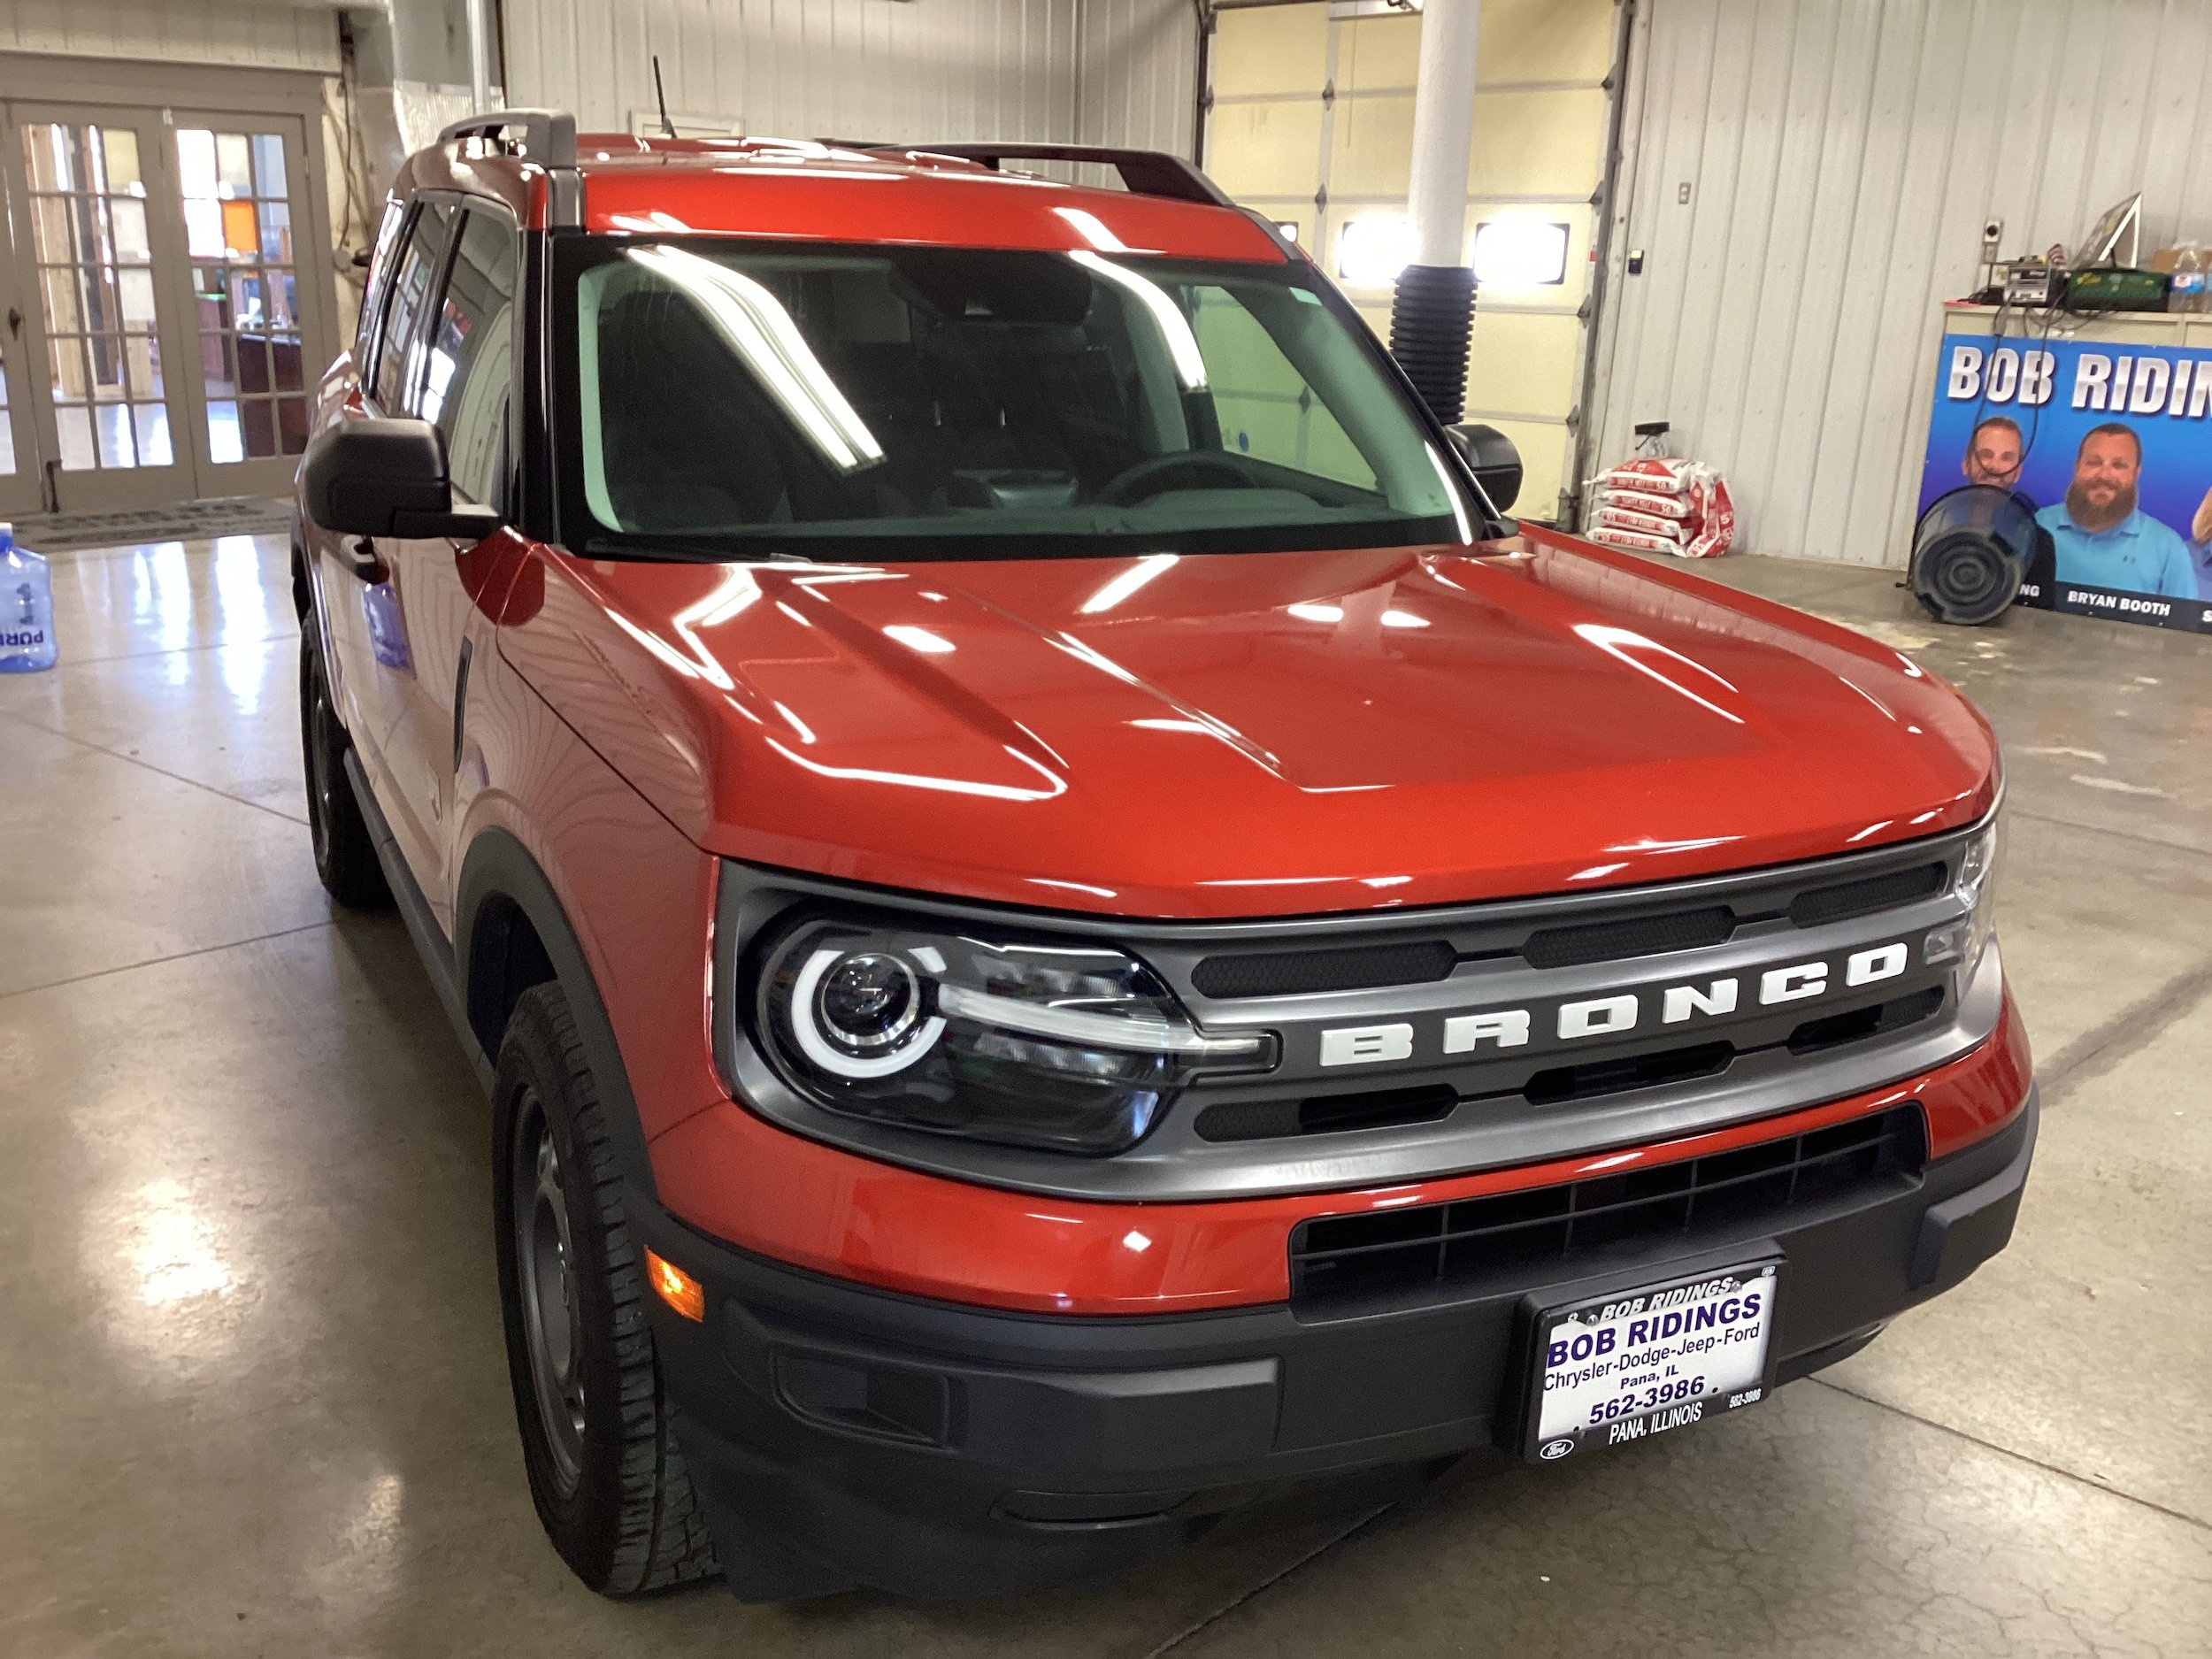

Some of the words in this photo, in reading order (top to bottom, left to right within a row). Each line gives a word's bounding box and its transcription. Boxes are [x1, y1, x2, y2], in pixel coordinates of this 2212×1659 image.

[1947, 346, 2055, 404] BOB
[2067, 590, 2117, 609] BRYAN
[2120, 597, 2171, 617] BOOTH
[1319, 942, 1909, 1067] BRONCO
[1600, 1298, 1645, 1321] BOB
[1647, 1276, 1733, 1312] RIDINGS
[1547, 1327, 1617, 1369] BOB
[1627, 1293, 1762, 1348] RIDINGS
[1543, 1322, 1760, 1391] Chrysler-Dodge-Jeep-Ford
[1620, 1372, 1660, 1389] Pana,
[1665, 1364, 1679, 1377] IL
[1589, 1376, 1705, 1424] 562-3986
[1609, 1421, 1647, 1445] PANA,
[1650, 1401, 1703, 1434] ILLINOIS
